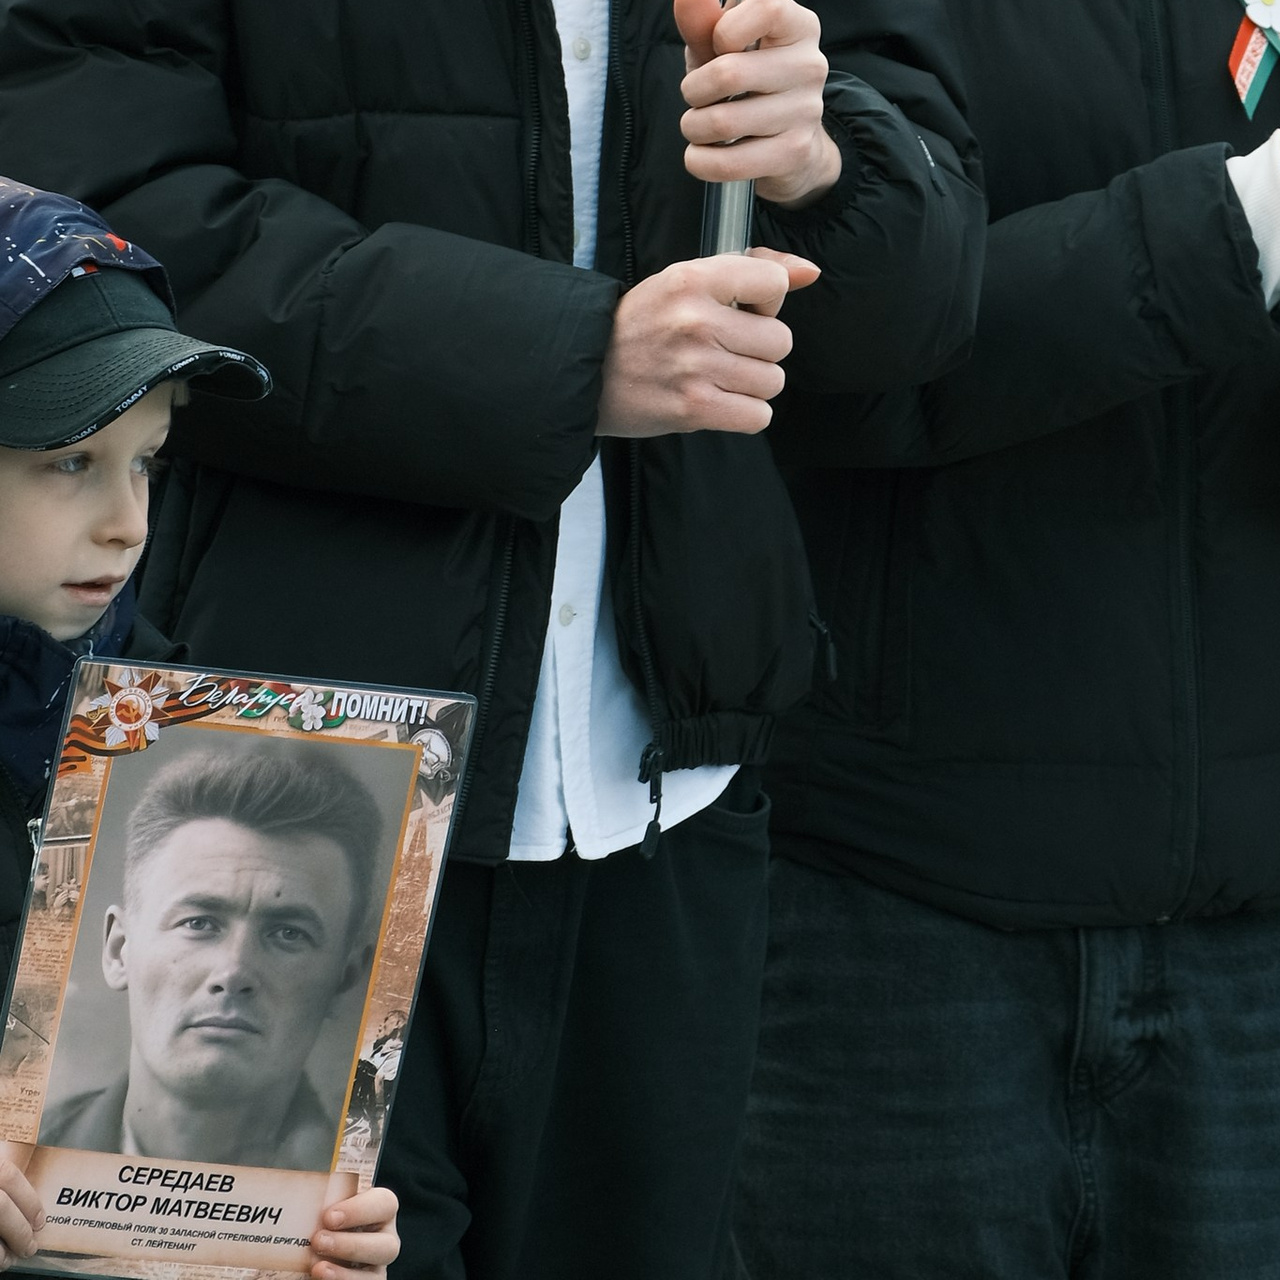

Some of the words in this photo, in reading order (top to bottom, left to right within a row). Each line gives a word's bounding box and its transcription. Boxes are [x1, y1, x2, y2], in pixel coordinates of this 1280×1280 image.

[114, 384, 148, 413] TOMMY
[63, 423, 98, 444] TOMMY
[330, 691, 430, 726] ПОМНИТ!
[118, 1165, 236, 1193] СЕРЕДАЕВ
[56, 1187, 148, 1213] ВИКТОР
[149, 1196, 283, 1225] МАТВЕЕВИЧ
[72, 1218, 133, 1232] СТРЕЛКОВЫЙ
[132, 1224, 158, 1235] ПОЛК
[157, 1227, 169, 1236] 30
[169, 1228, 217, 1239] ЗАПАСНОЙ
[217, 1232, 273, 1245] СТРЕЛКОВОЙ
[144, 1238, 197, 1252] ЛЕЙТЕНАНТ
